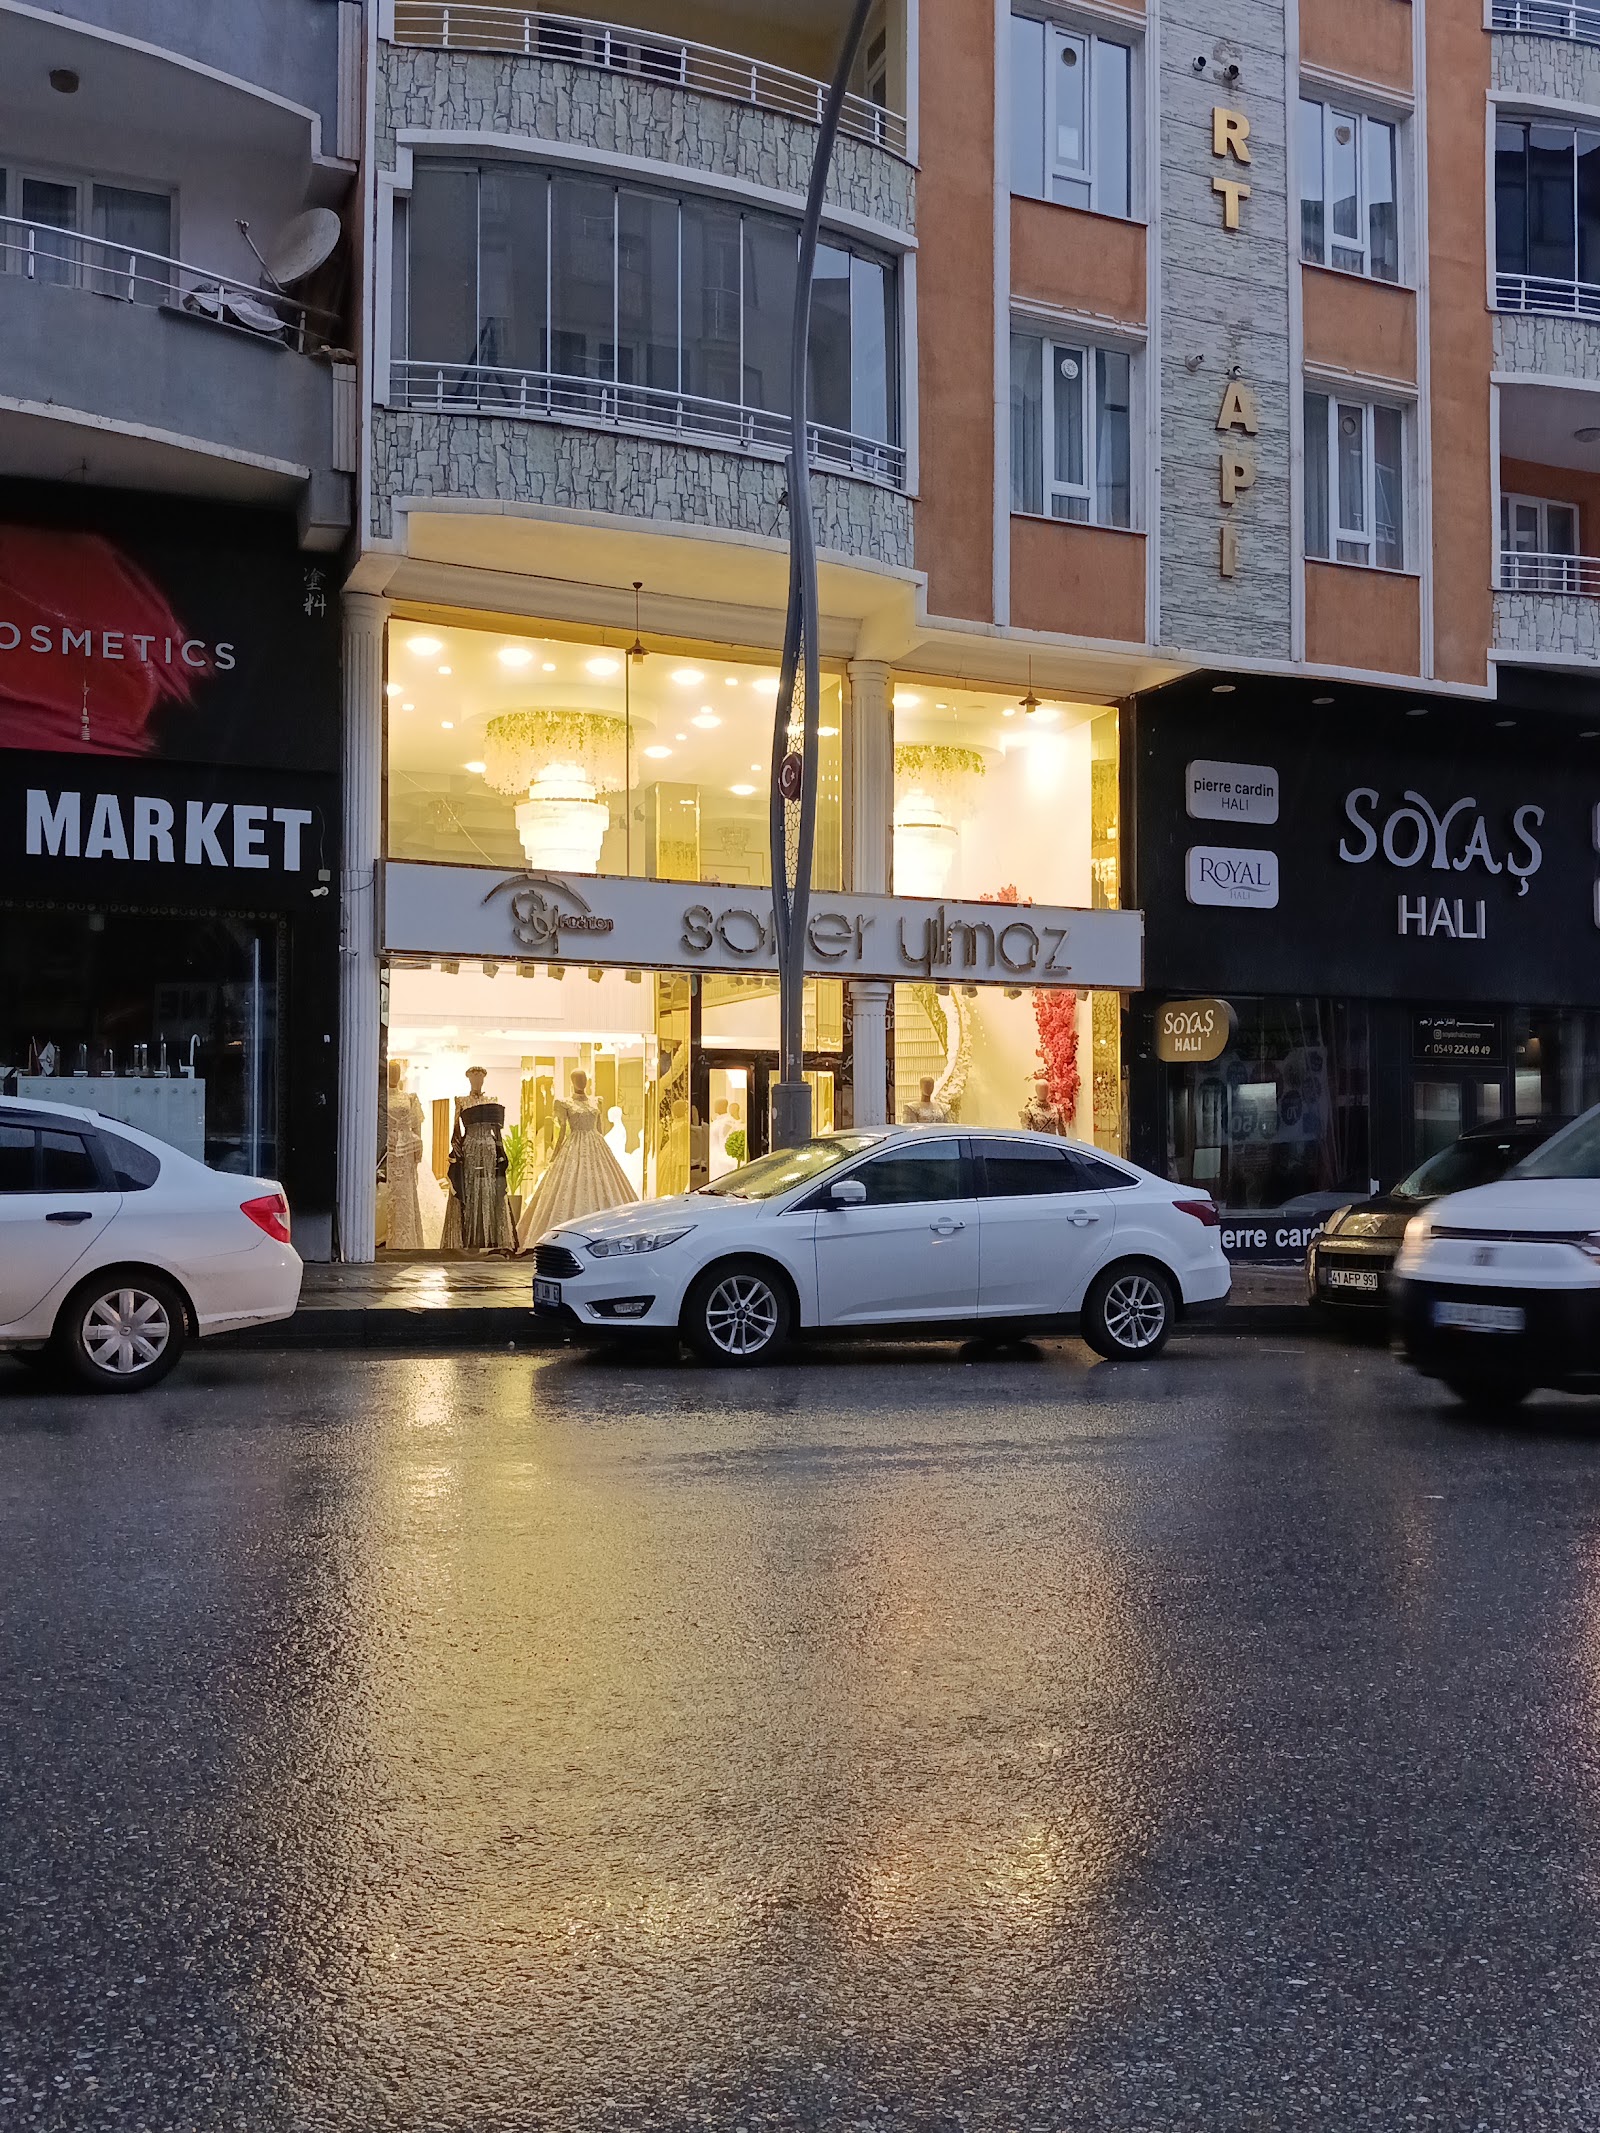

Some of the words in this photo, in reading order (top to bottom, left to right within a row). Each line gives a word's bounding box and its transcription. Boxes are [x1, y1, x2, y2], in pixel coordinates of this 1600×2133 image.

[1194, 778, 1231, 794] pierre
[1235, 783, 1274, 797] cardin
[1221, 797, 1249, 811] HALI
[26, 788, 313, 871] MARKET
[1338, 787, 1546, 896] SOYAŞ
[1199, 857, 1271, 889] ROYAL
[1230, 890, 1251, 900] HALI
[1398, 894, 1487, 940] HALI
[680, 904, 877, 960] soer
[1163, 1009, 1215, 1038] SOYAŞ
[1174, 1037, 1202, 1052] HALI
[1433, 1044, 1453, 1054] 0549
[1454, 1045, 1469, 1054] 224
[1469, 1045, 1480, 1055] 49
[1480, 1046, 1491, 1055] 49
[1220, 1228, 1267, 1249] erre
[1332, 1272, 1341, 1284] 41
[1343, 1272, 1361, 1285] AFP
[1362, 1274, 1377, 1287] 991
